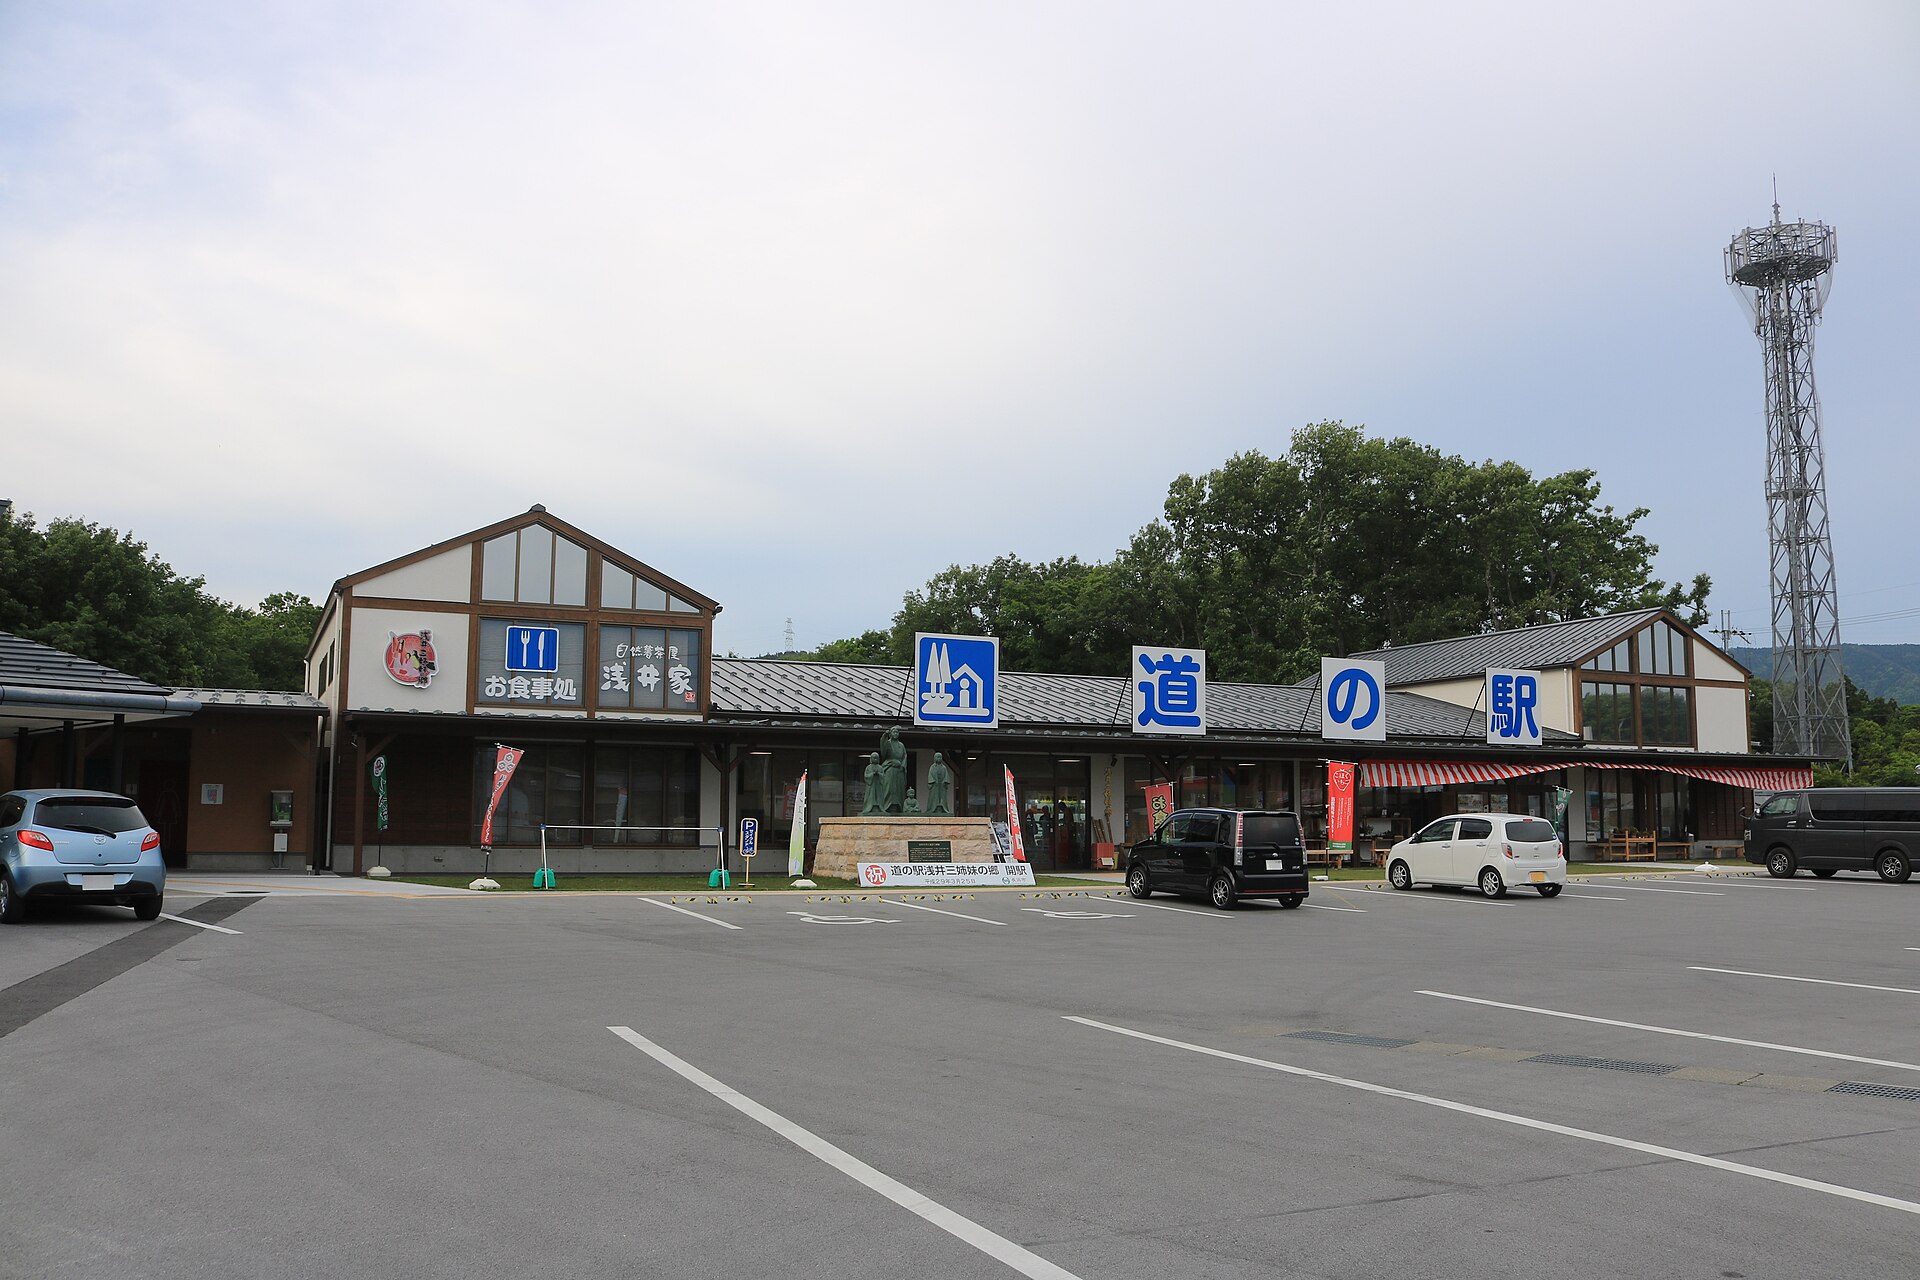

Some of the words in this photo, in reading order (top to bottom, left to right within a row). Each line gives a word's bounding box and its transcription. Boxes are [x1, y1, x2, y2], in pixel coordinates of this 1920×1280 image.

[484, 675, 577, 701] お食事処
[601, 661, 693, 695] 浅井家
[1137, 653, 1202, 728] 道
[1326, 667, 1381, 730] の
[1490, 673, 1540, 739] 駅
[745, 821, 755, 830] P
[866, 866, 885, 883] 祝
[890, 865, 1000, 876] 道の駅浅井三姉妹の郷
[1005, 865, 1028, 876] 開駅
